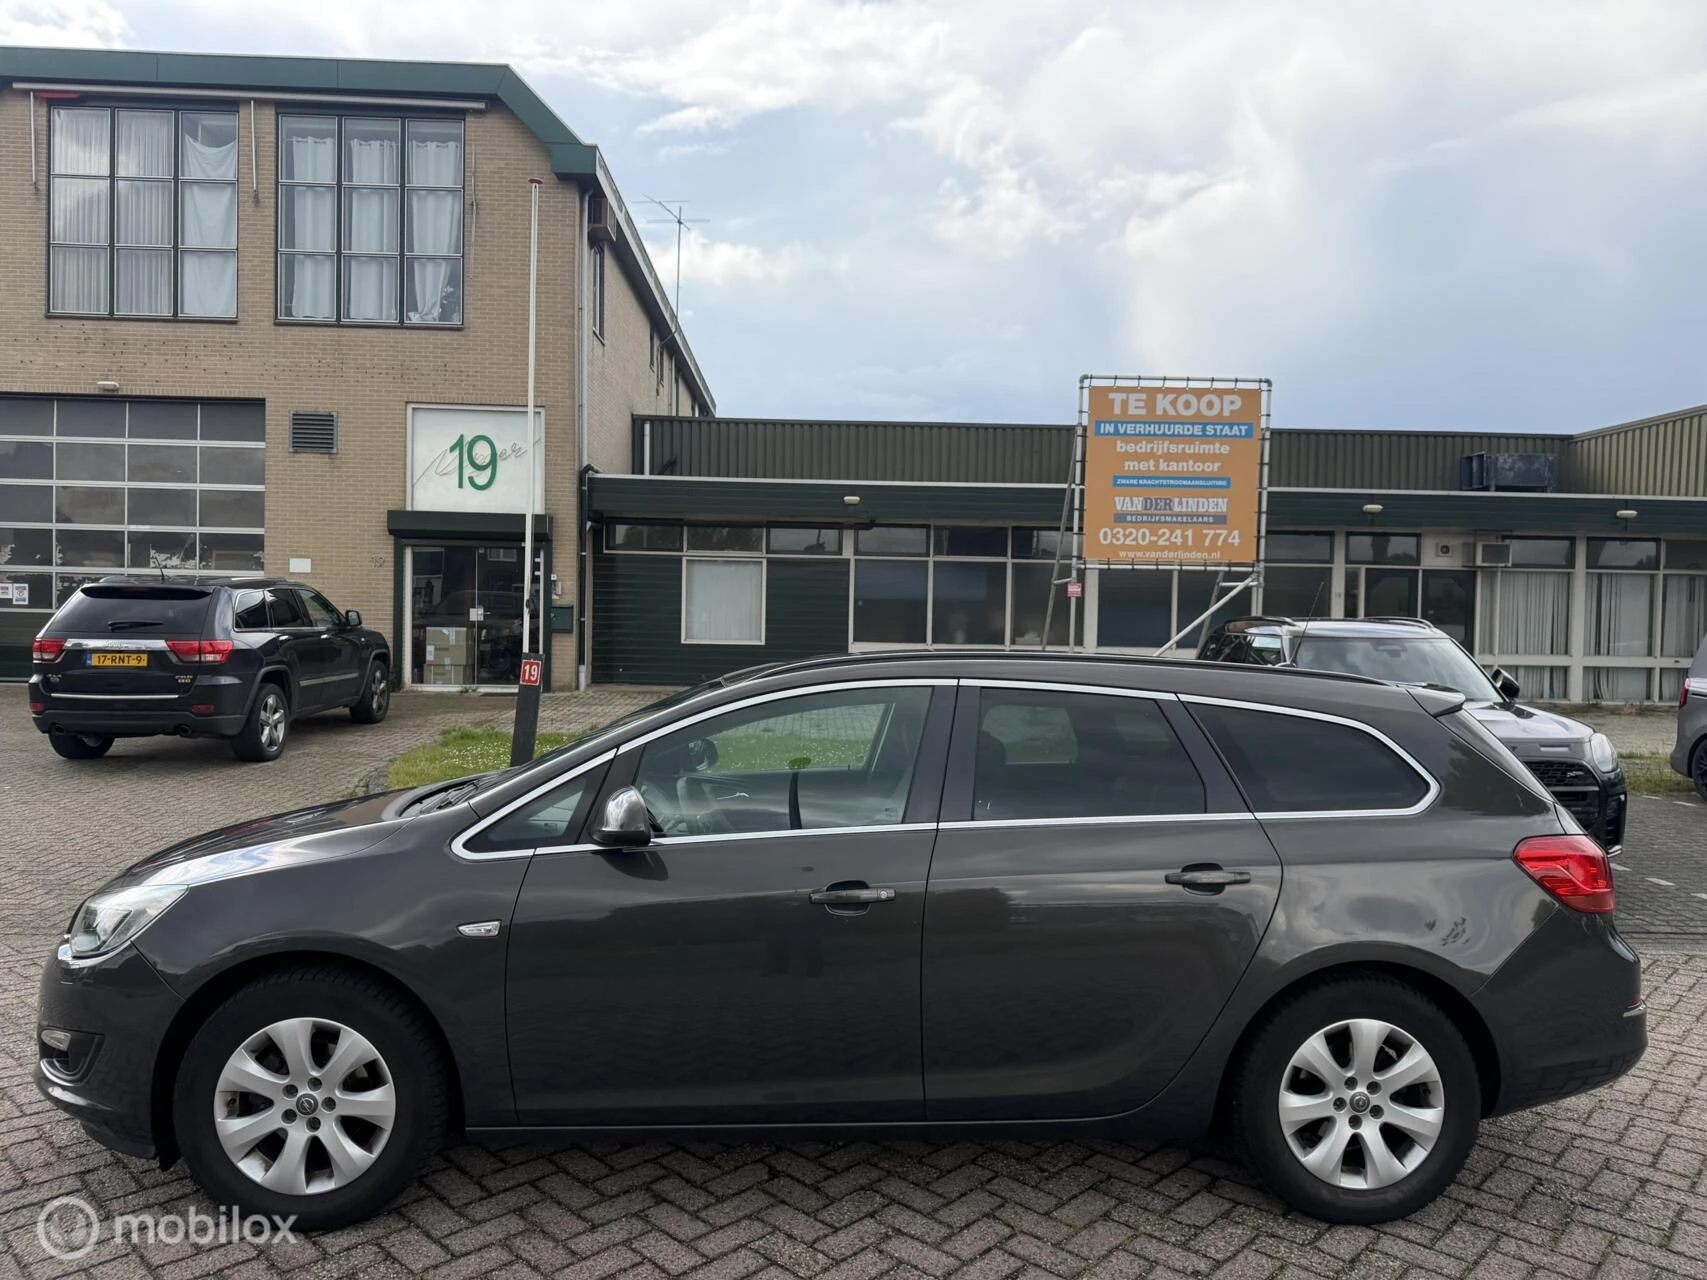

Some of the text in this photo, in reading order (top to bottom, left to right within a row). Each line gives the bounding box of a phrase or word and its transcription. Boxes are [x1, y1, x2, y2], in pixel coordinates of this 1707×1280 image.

[1108, 392, 1242, 417] TE KOOP
[1100, 423, 1249, 436] IN VERHUURDE STAAT
[1116, 440, 1230, 455] bedrijfsruimte
[449, 434, 497, 491] 19
[1124, 459, 1221, 472] met kantoor
[1126, 515, 1214, 523] BEDRIJFSMAKELAARS
[1099, 527, 1241, 547] 0320-241 774
[1119, 549, 1221, 559] www.vanderlinden.nl
[97, 653, 142, 665] 17-RNT-9
[524, 664, 538, 681] 19
